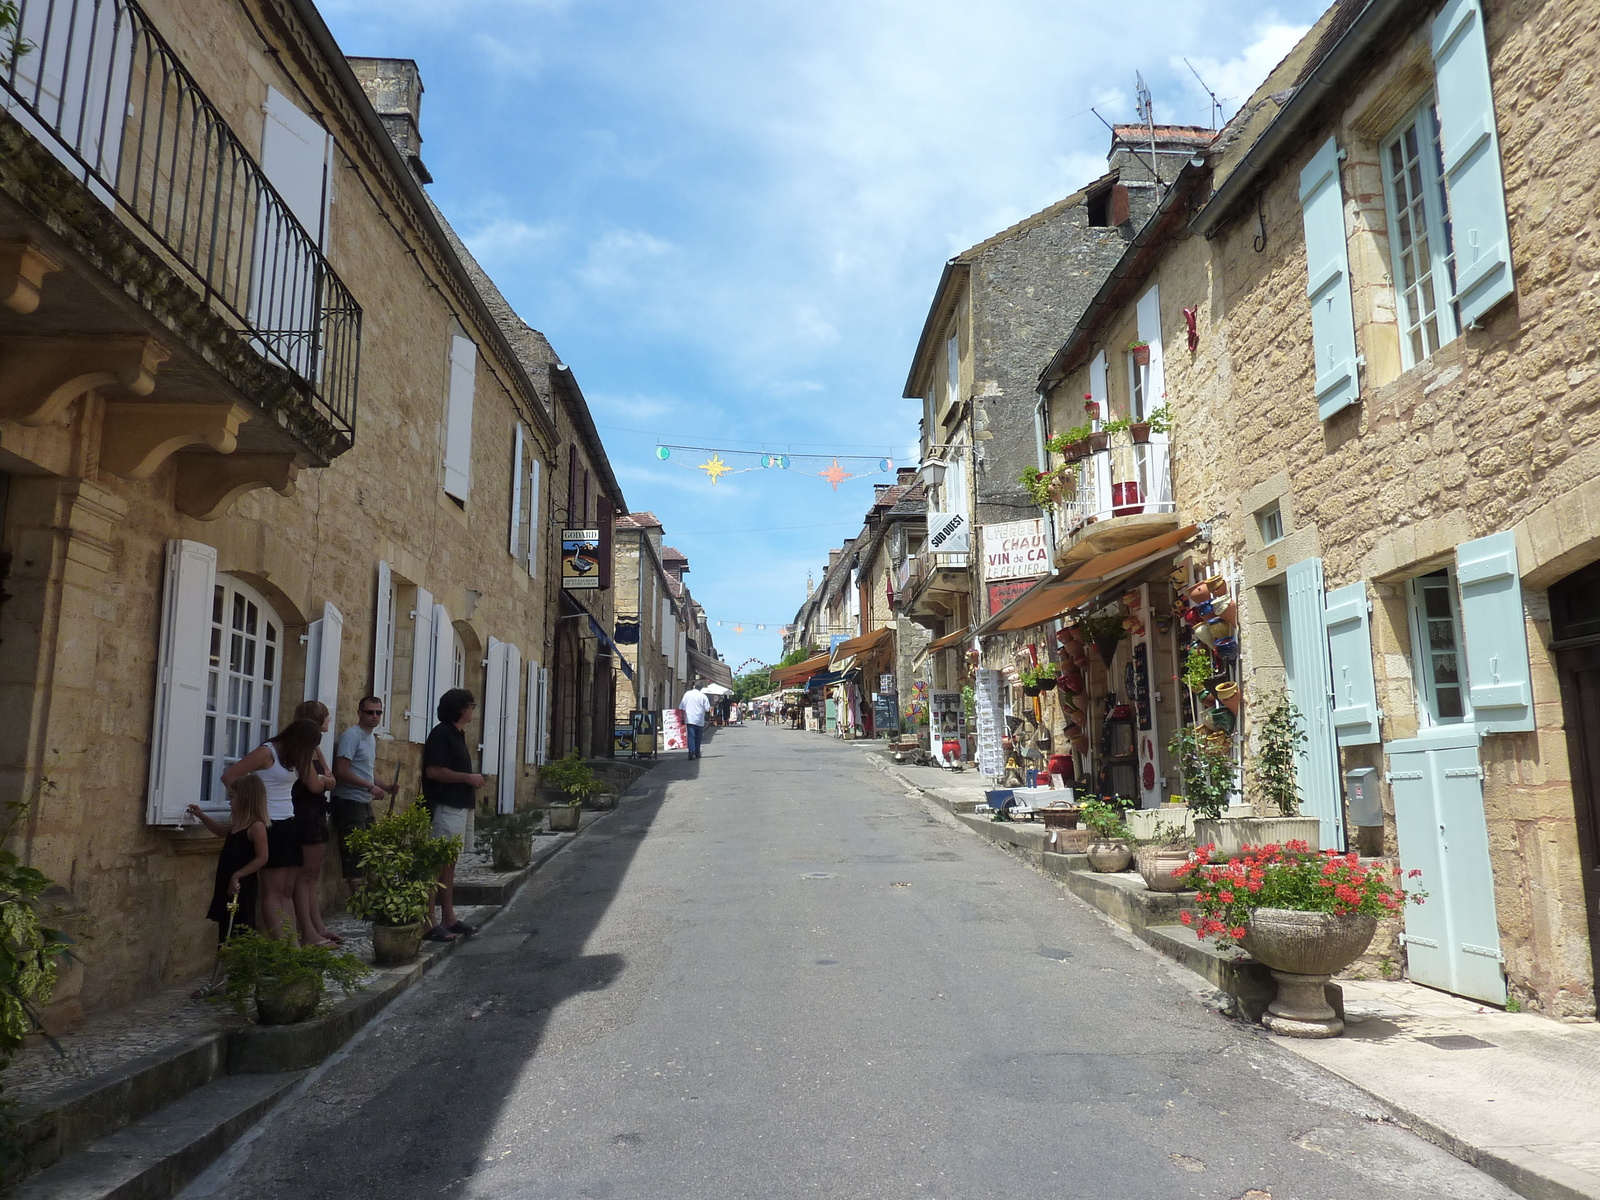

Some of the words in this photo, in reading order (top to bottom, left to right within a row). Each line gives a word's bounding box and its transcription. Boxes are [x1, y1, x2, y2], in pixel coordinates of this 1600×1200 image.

[564, 531, 597, 539] GODARD
[931, 531, 947, 548] SUD
[942, 514, 965, 536] OUEST
[988, 553, 1010, 566] VIN
[1013, 553, 1024, 564] de
[1000, 563, 1040, 577] CELLIER
